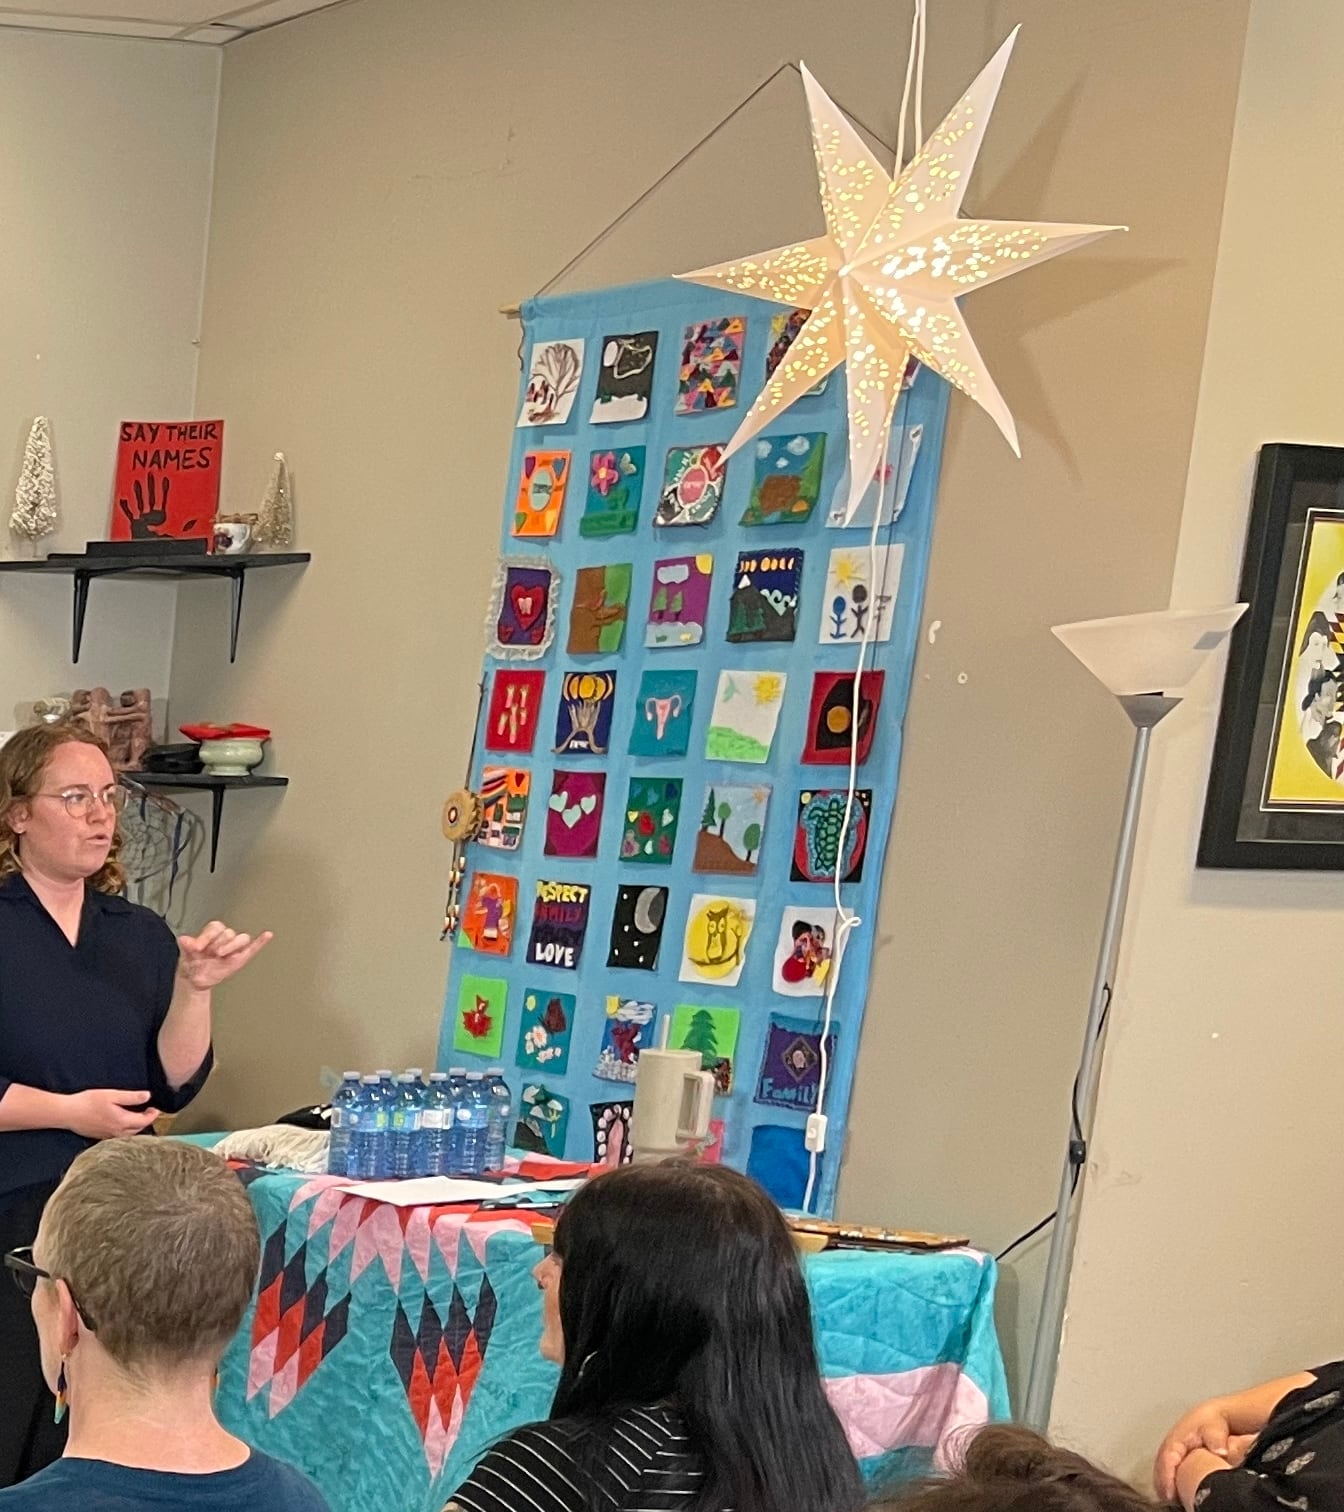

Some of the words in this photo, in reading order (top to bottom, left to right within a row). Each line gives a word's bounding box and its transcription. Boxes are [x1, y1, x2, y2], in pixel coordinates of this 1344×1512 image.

[120, 422, 160, 443] SAY
[165, 422, 218, 443] THEIR
[131, 446, 213, 471] NAMES
[535, 942, 574, 967] LOVE
